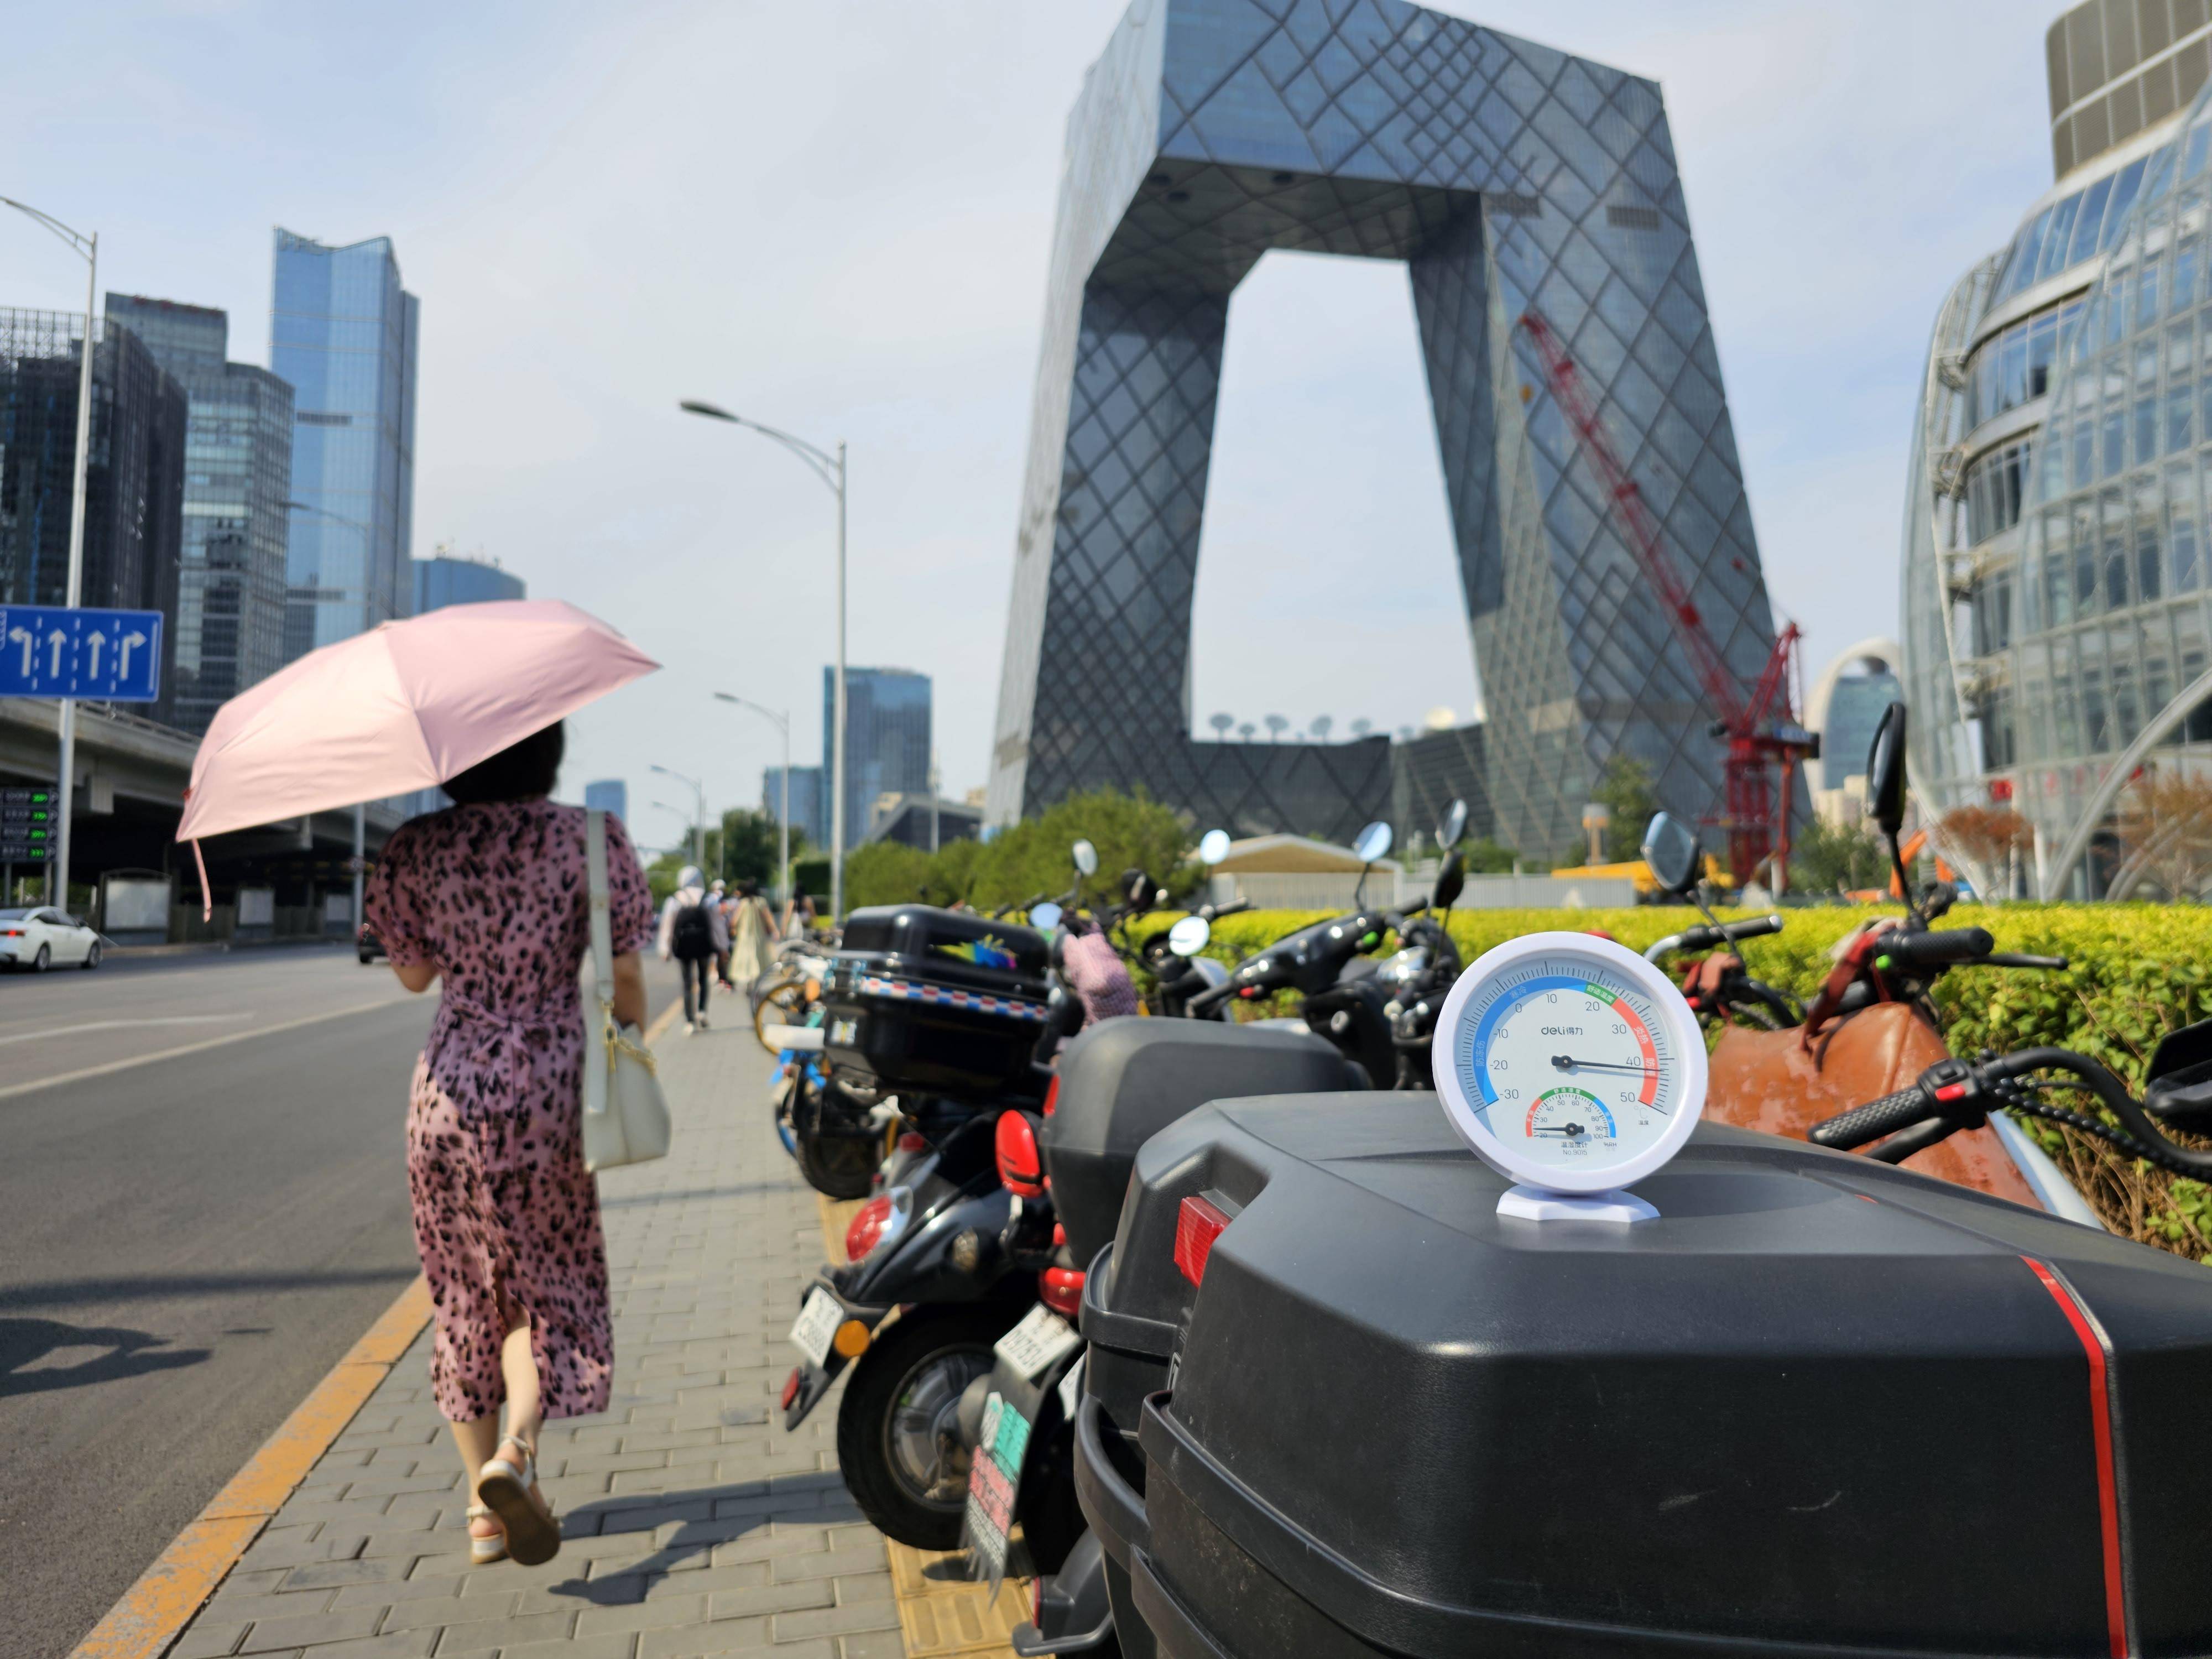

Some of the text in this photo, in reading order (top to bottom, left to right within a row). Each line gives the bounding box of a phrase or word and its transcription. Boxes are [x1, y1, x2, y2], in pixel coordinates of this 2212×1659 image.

[1546, 994, 1557, 1003] 10
[1587, 984, 1615, 1003] 舒适温度
[1515, 1003, 1522, 1013] 0
[1585, 1001, 1600, 1011] 20
[1494, 1029, 1508, 1038] -10
[1611, 1024, 1626, 1034] 30
[1634, 1026, 1649, 1044] 炎热
[1475, 1039, 1485, 1067] 防冻伤
[1490, 1060, 1508, 1070] -20
[1626, 1056, 1641, 1066] 40
[1499, 1089, 1519, 1099] -30
[1620, 1092, 1635, 1102] 50
